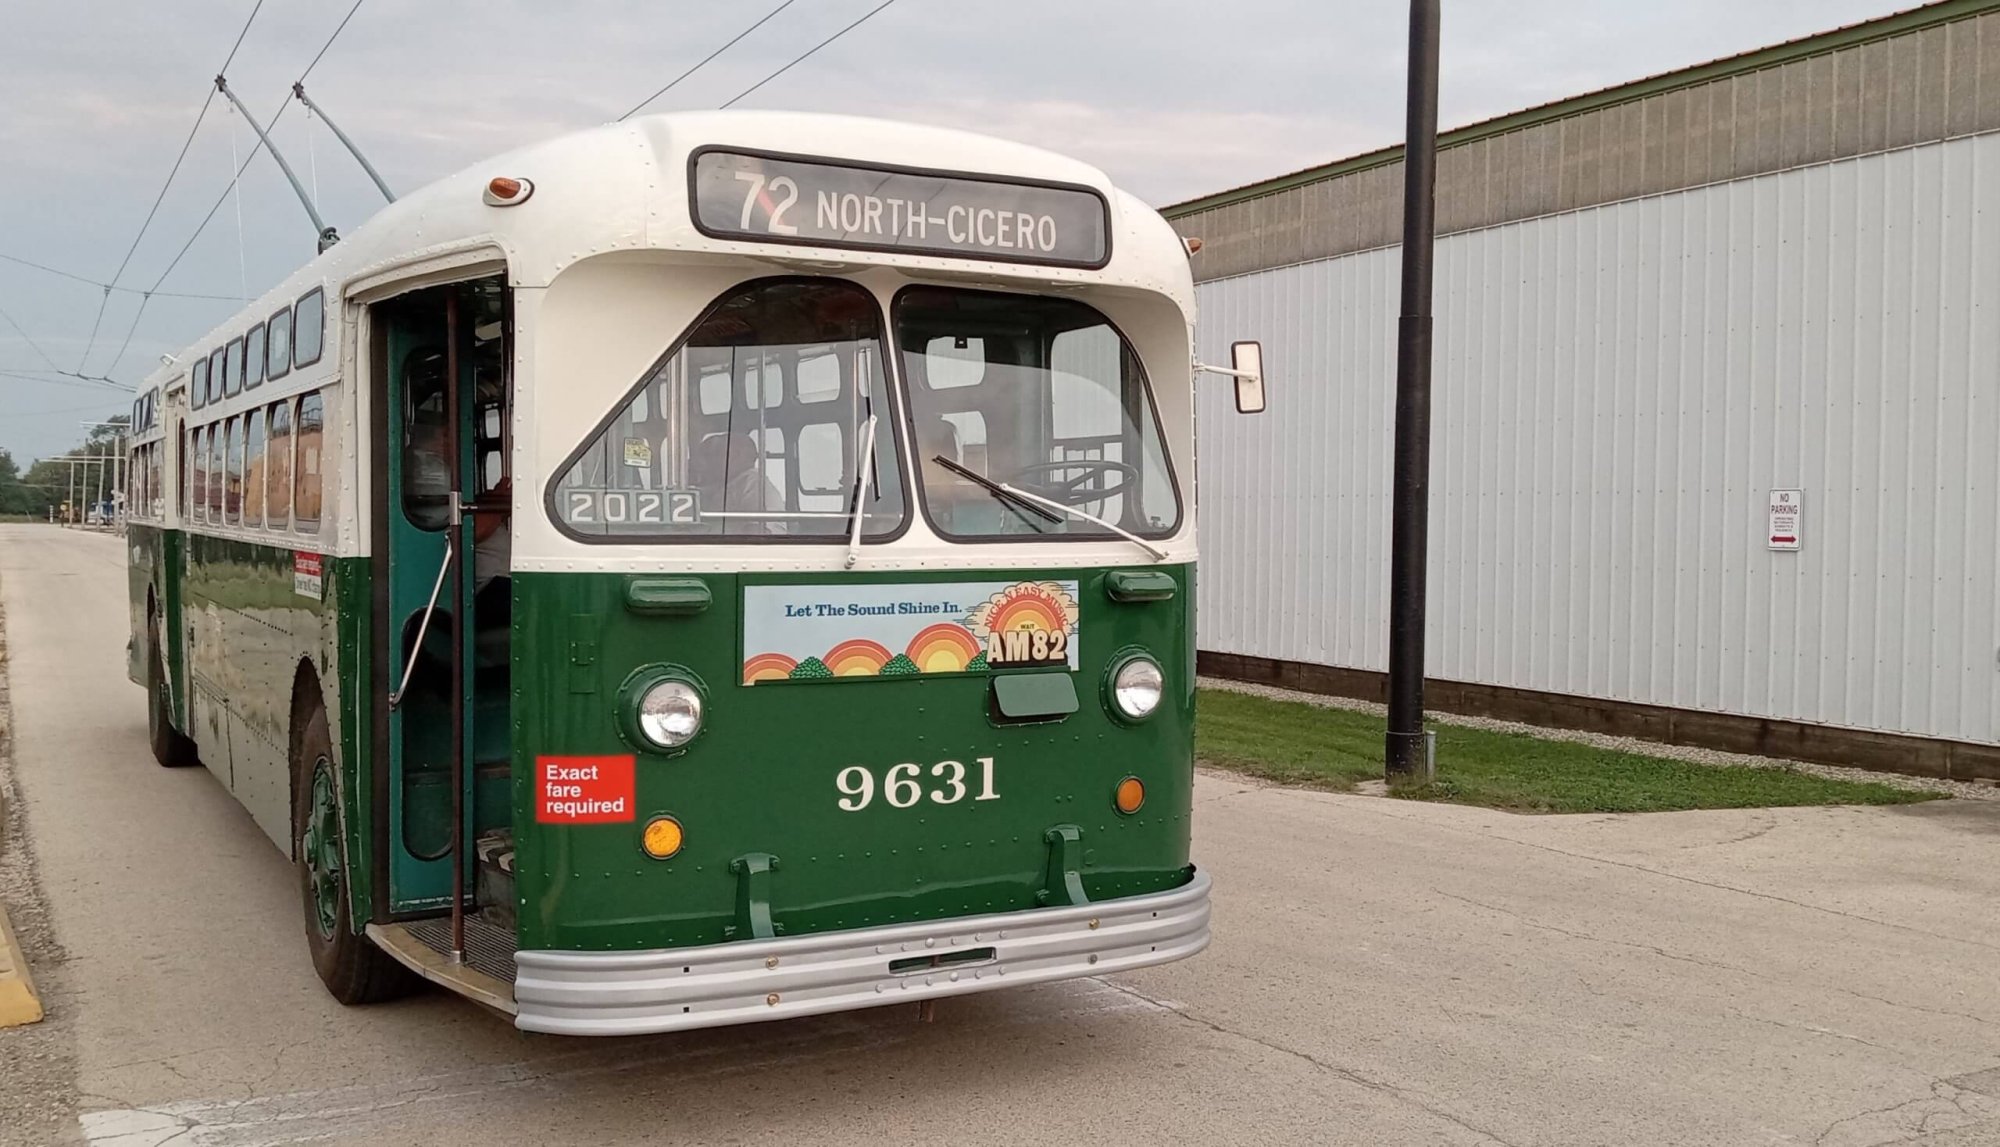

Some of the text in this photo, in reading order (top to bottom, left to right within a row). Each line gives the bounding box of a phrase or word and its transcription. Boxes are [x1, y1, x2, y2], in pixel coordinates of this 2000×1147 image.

[734, 171, 1057, 251] 72 NORTH-CICERO
[1780, 493, 1789, 503] NO
[571, 493, 694, 522] 2022
[1771, 504, 1798, 515] PARKING
[785, 601, 963, 617] Let The Sound Shine In.
[546, 764, 599, 780] Exact
[545, 782, 582, 798] fare
[836, 757, 1001, 812] 9631
[546, 797, 624, 818] required
